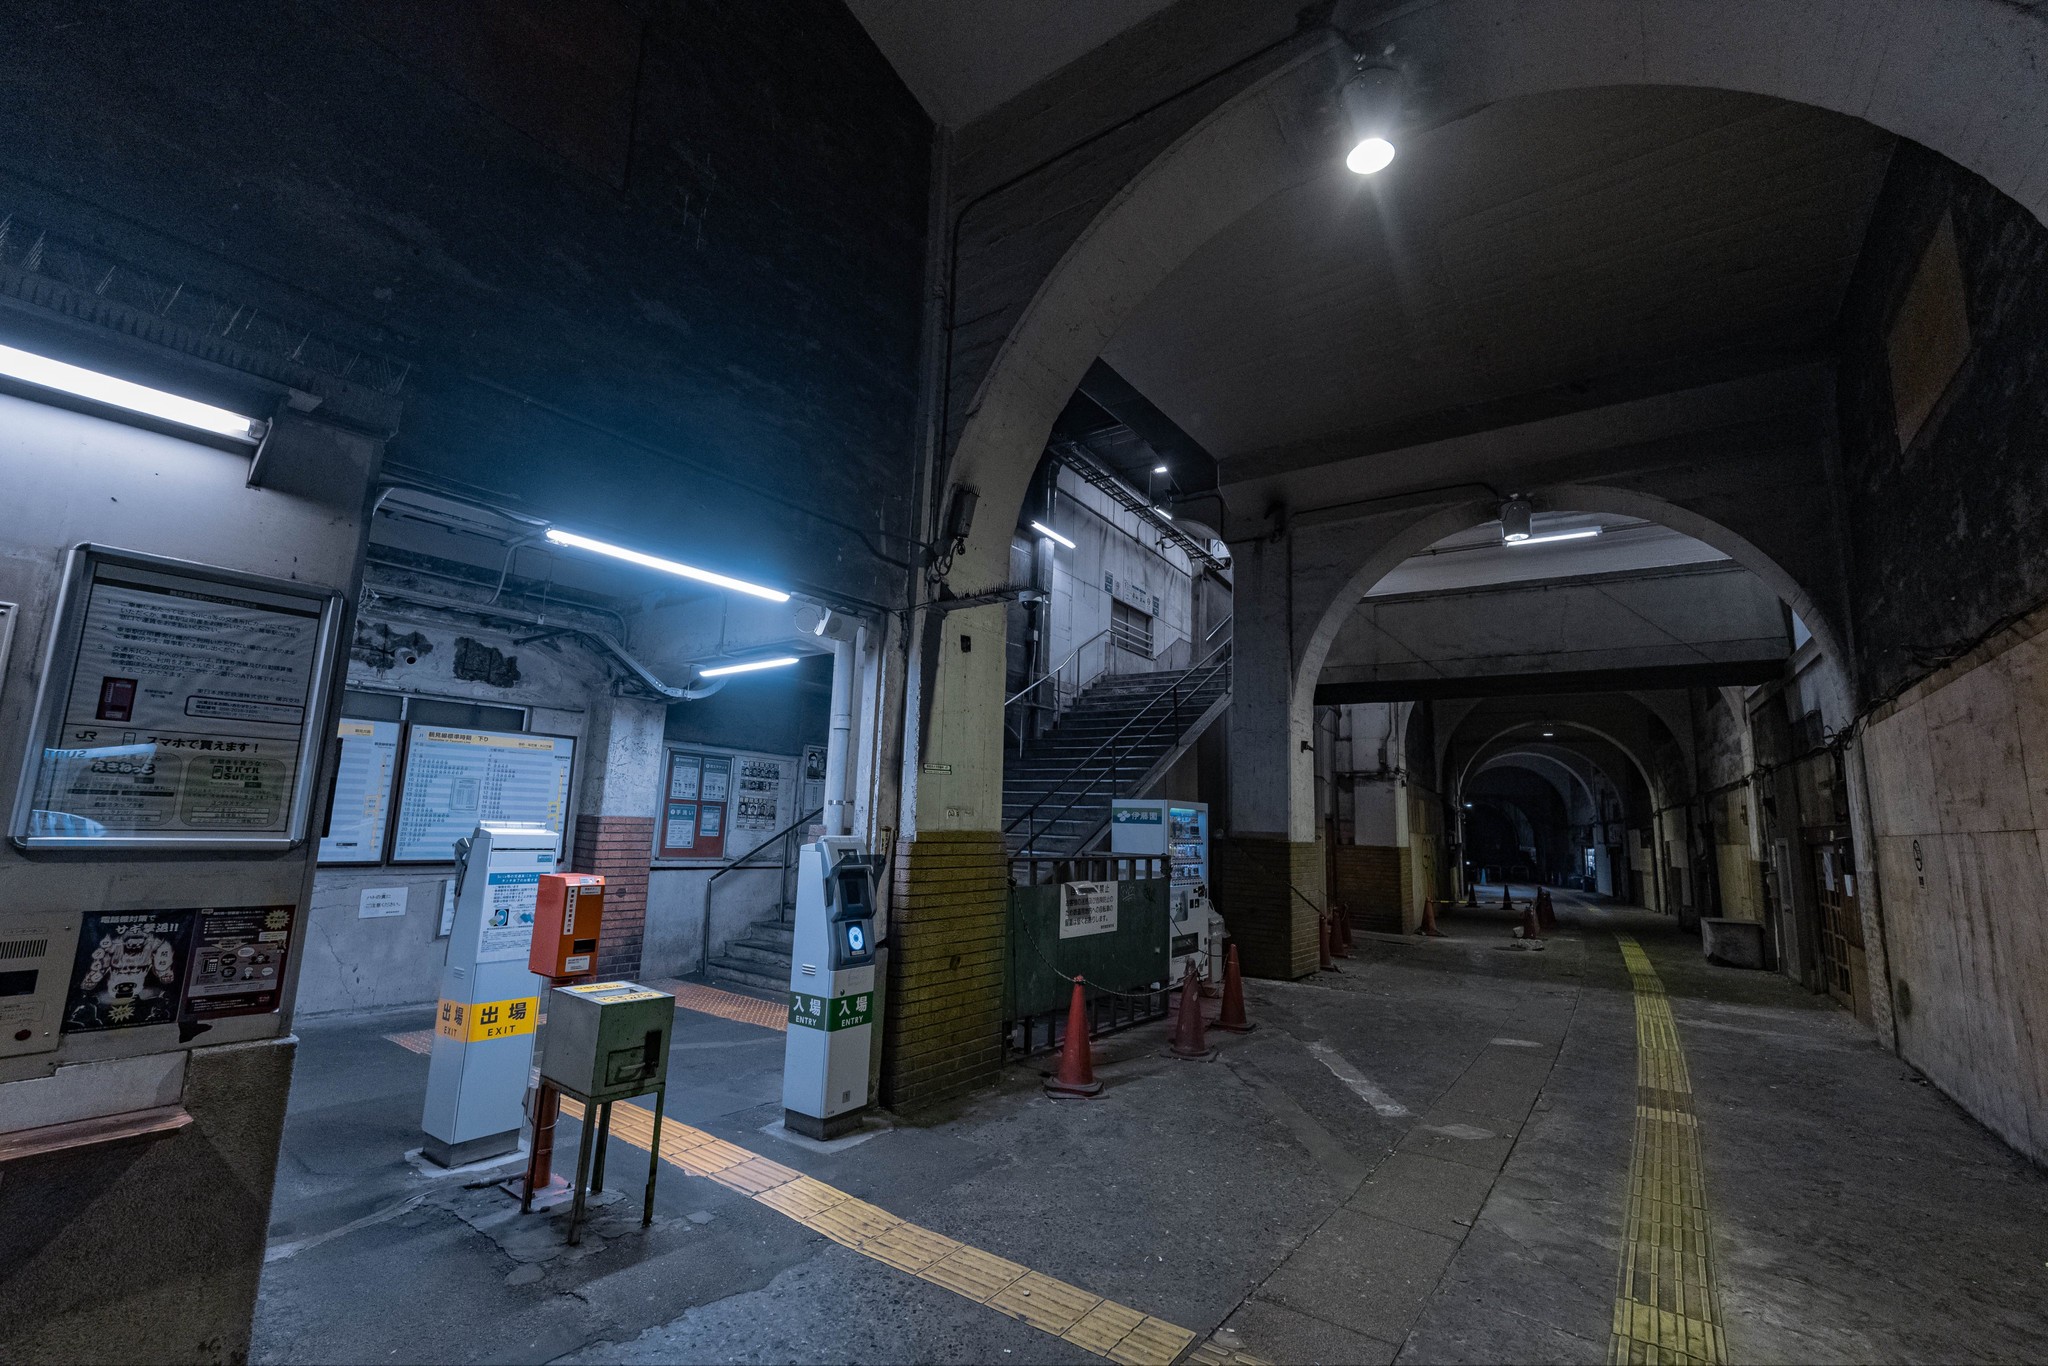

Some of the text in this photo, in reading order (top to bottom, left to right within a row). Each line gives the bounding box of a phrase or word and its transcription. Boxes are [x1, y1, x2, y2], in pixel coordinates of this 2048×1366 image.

[74, 729, 98, 739] JR
[145, 735, 259, 754] スマホで買えます！
[90, 759, 156, 776] えきねっと
[224, 765, 261, 774] モバイル
[223, 772, 259, 781] Suica
[1131, 811, 1158, 821] 伊藤園
[793, 995, 821, 1016] 入場
[838, 995, 868, 1017] 入場
[442, 1003, 464, 1026] 出場
[480, 1002, 527, 1025] 出場
[795, 1015, 817, 1026] ENTRY
[841, 1015, 864, 1027] ENTRY
[443, 1026, 457, 1037] EXIT
[487, 1025, 516, 1037] EXIT
